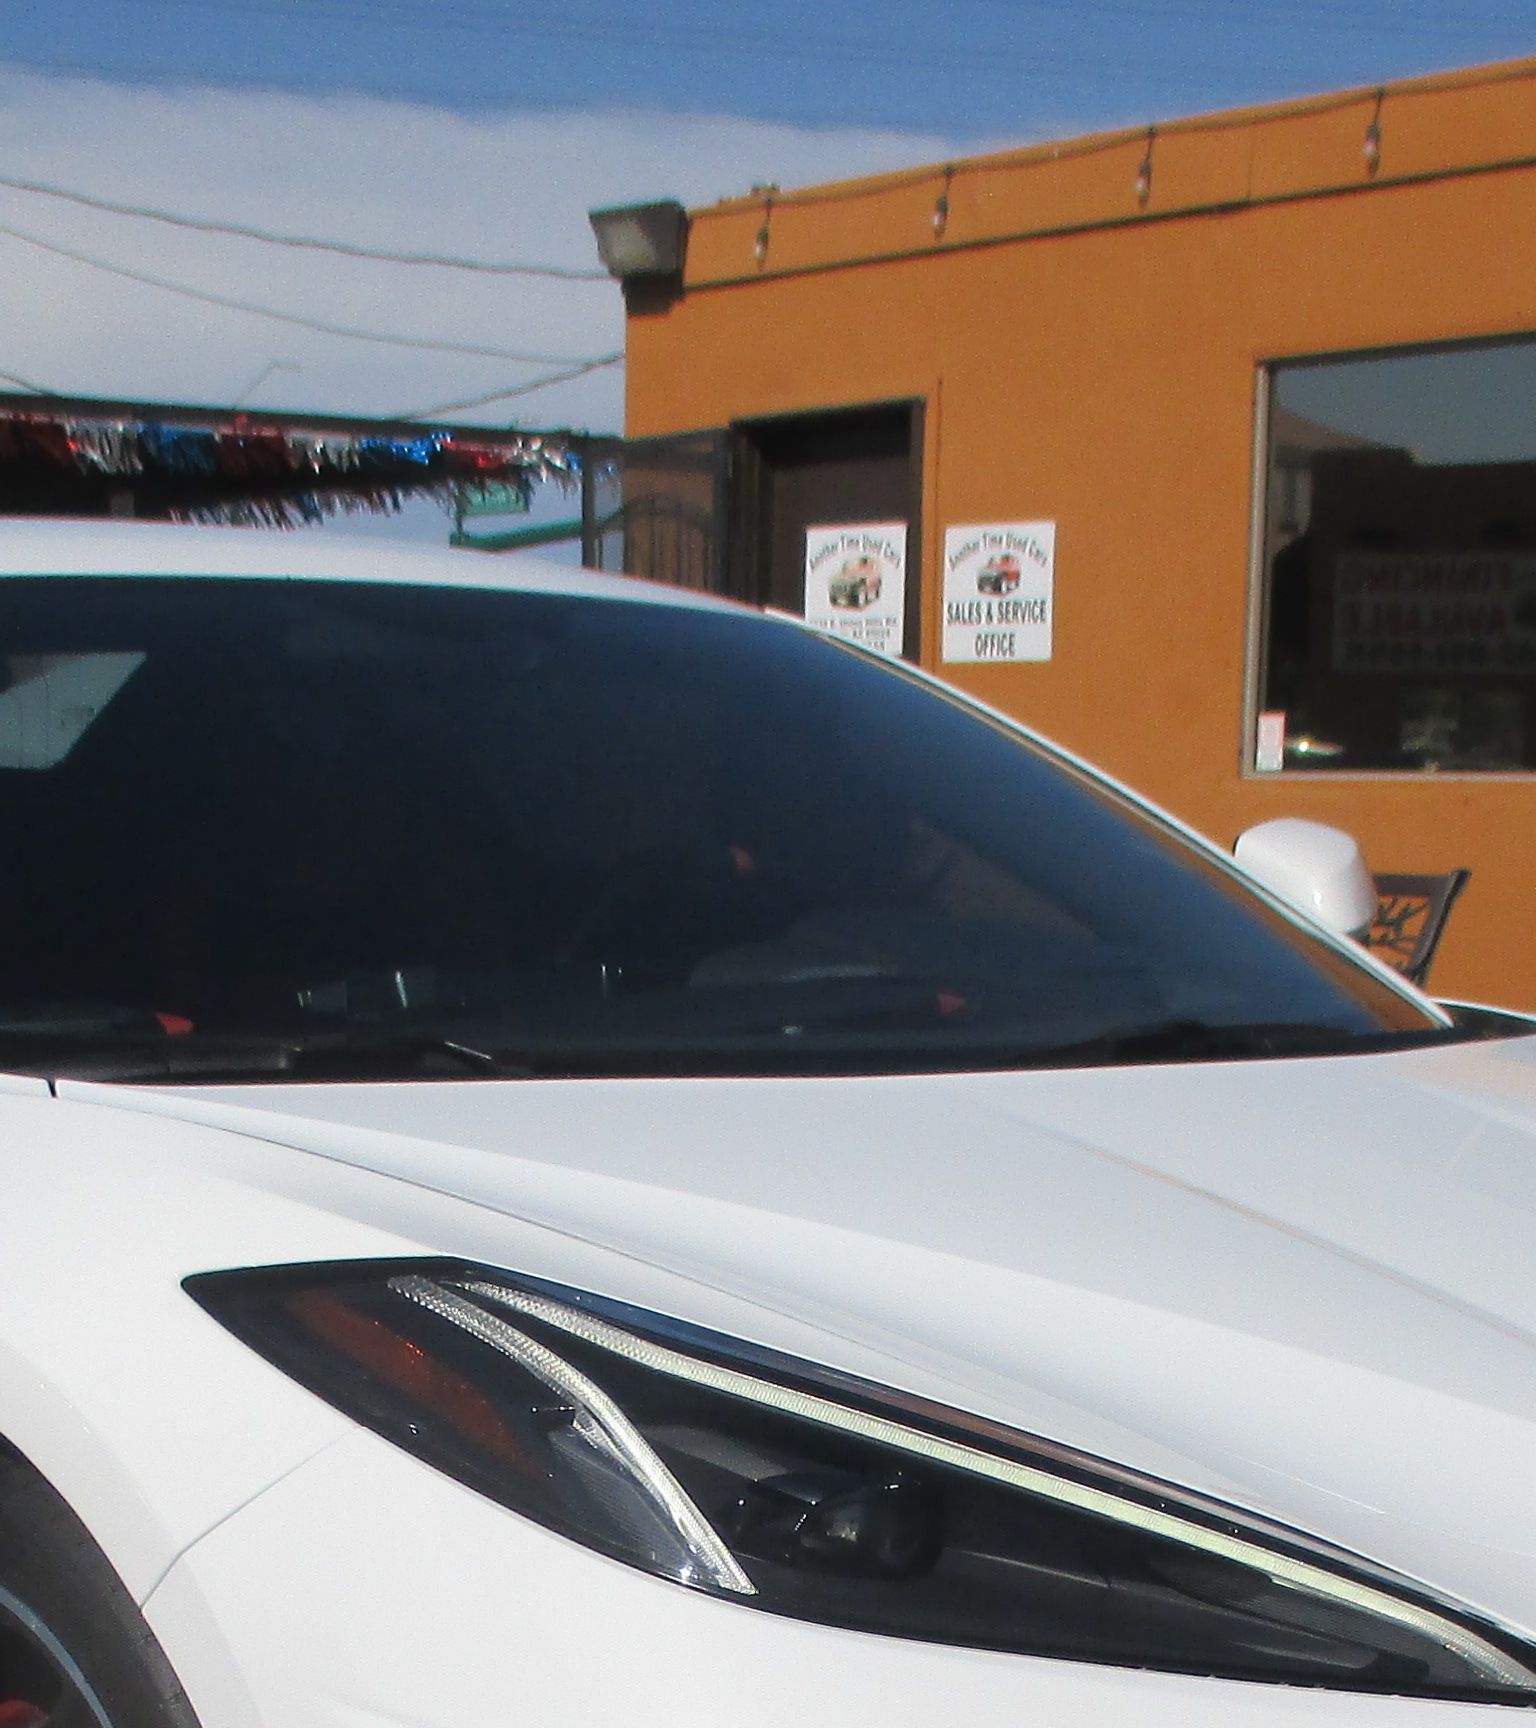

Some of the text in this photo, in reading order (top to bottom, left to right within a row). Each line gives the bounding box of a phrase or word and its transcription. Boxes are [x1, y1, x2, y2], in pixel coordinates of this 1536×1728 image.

[862, 535, 883, 555] Used
[982, 531, 1003, 550] Time
[1006, 531, 1029, 553] Used
[947, 598, 1047, 625] SALES & SERVICE
[974, 632, 1016, 657] OFFICE
